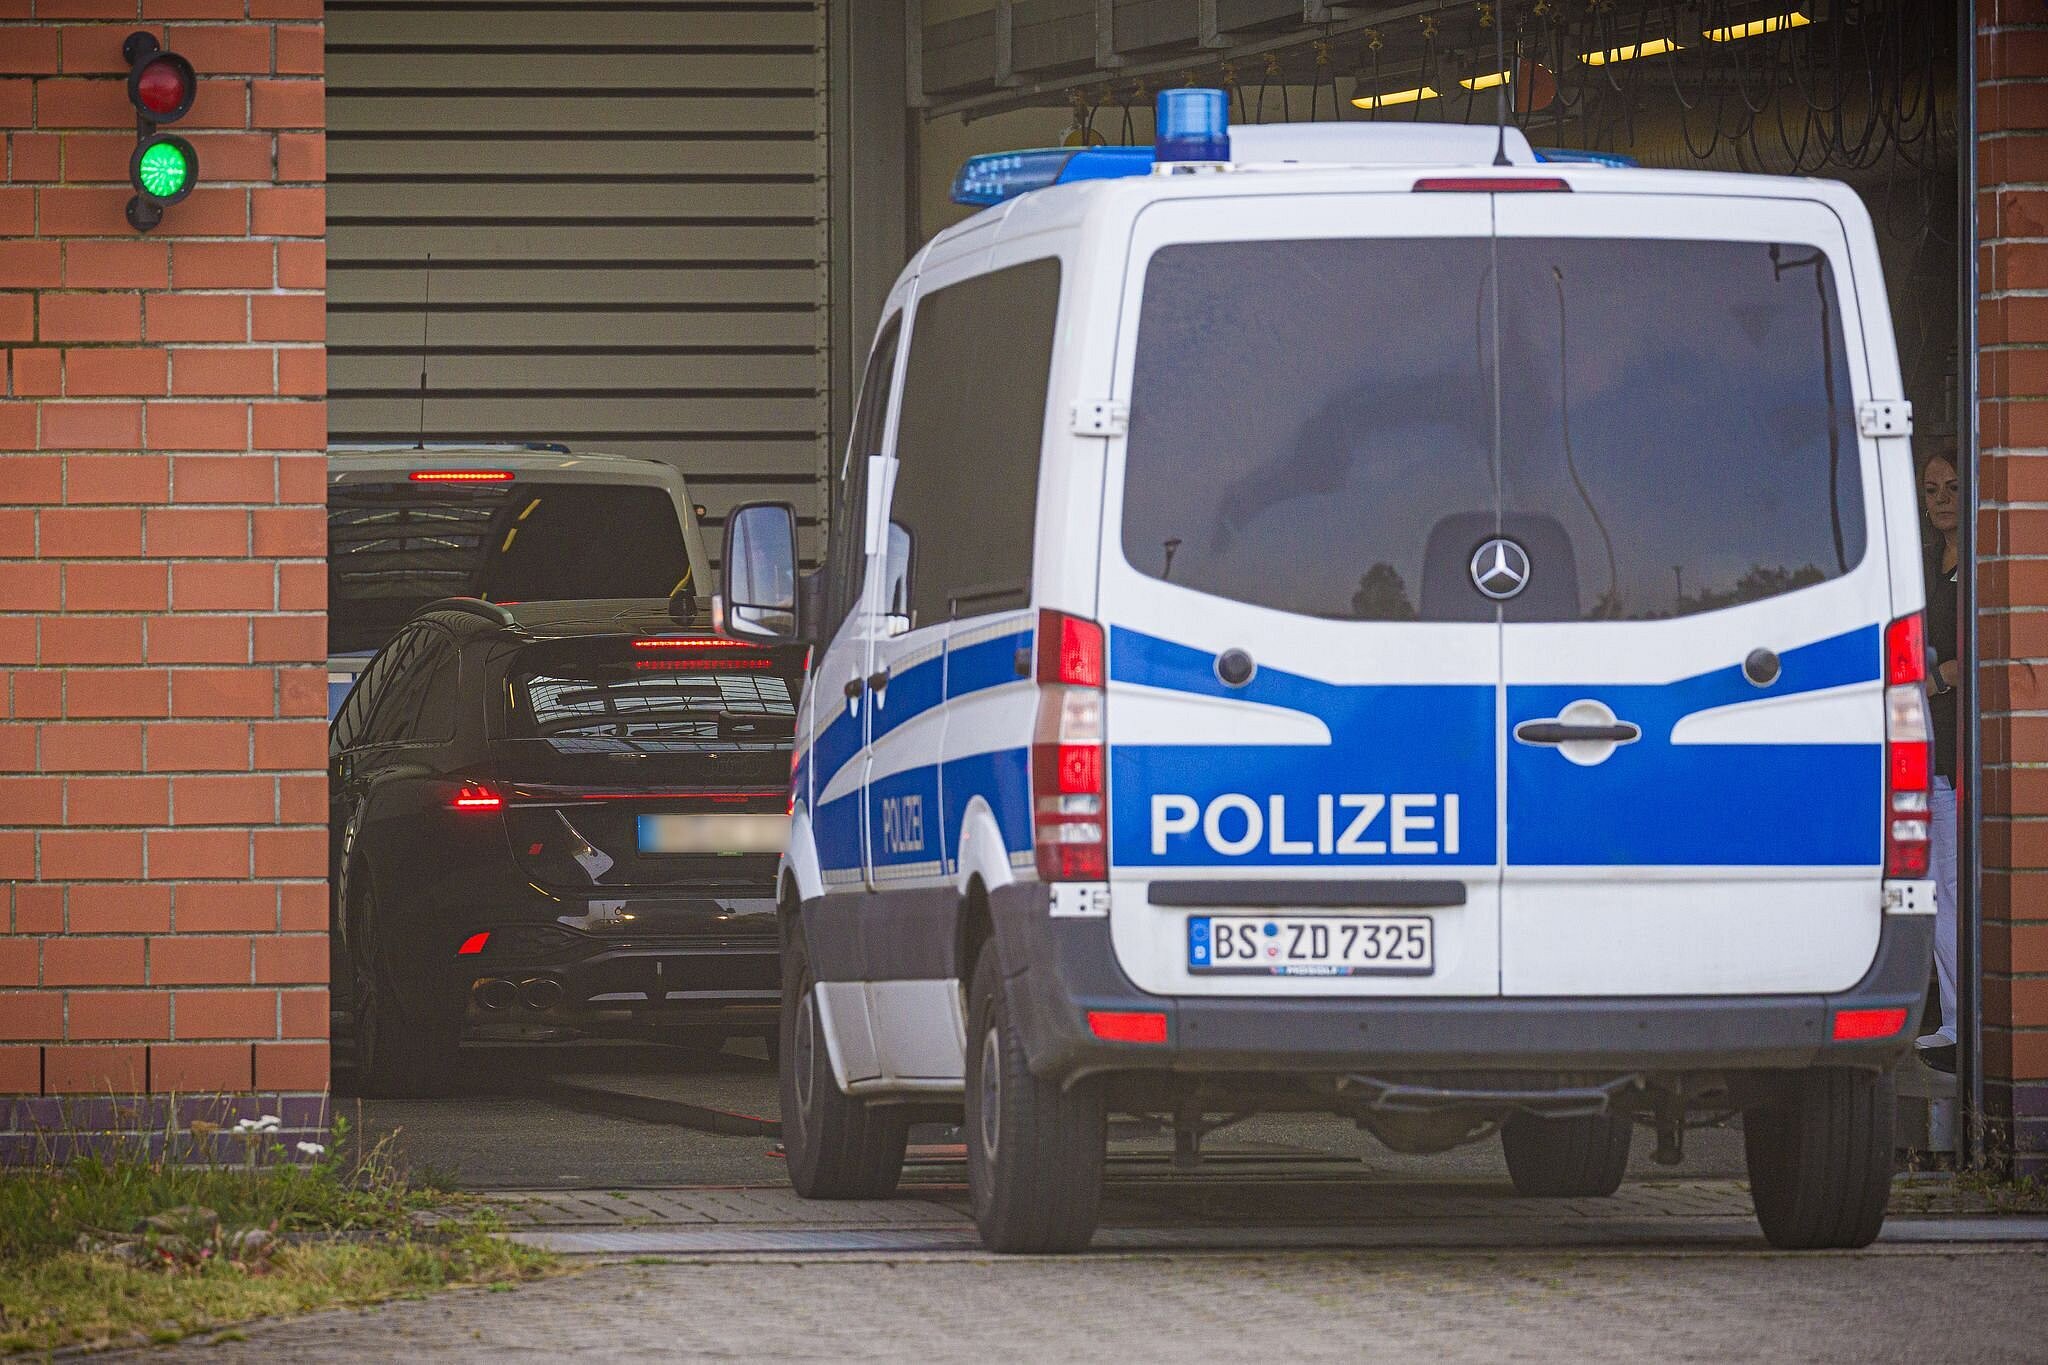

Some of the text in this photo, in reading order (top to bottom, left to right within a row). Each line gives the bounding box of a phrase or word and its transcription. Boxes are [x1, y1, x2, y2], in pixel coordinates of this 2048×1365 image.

[883, 795, 925, 854] POLIZEI
[1151, 793, 1459, 855] POLIZEI
[1215, 924, 1425, 959] BS ZD 7325
